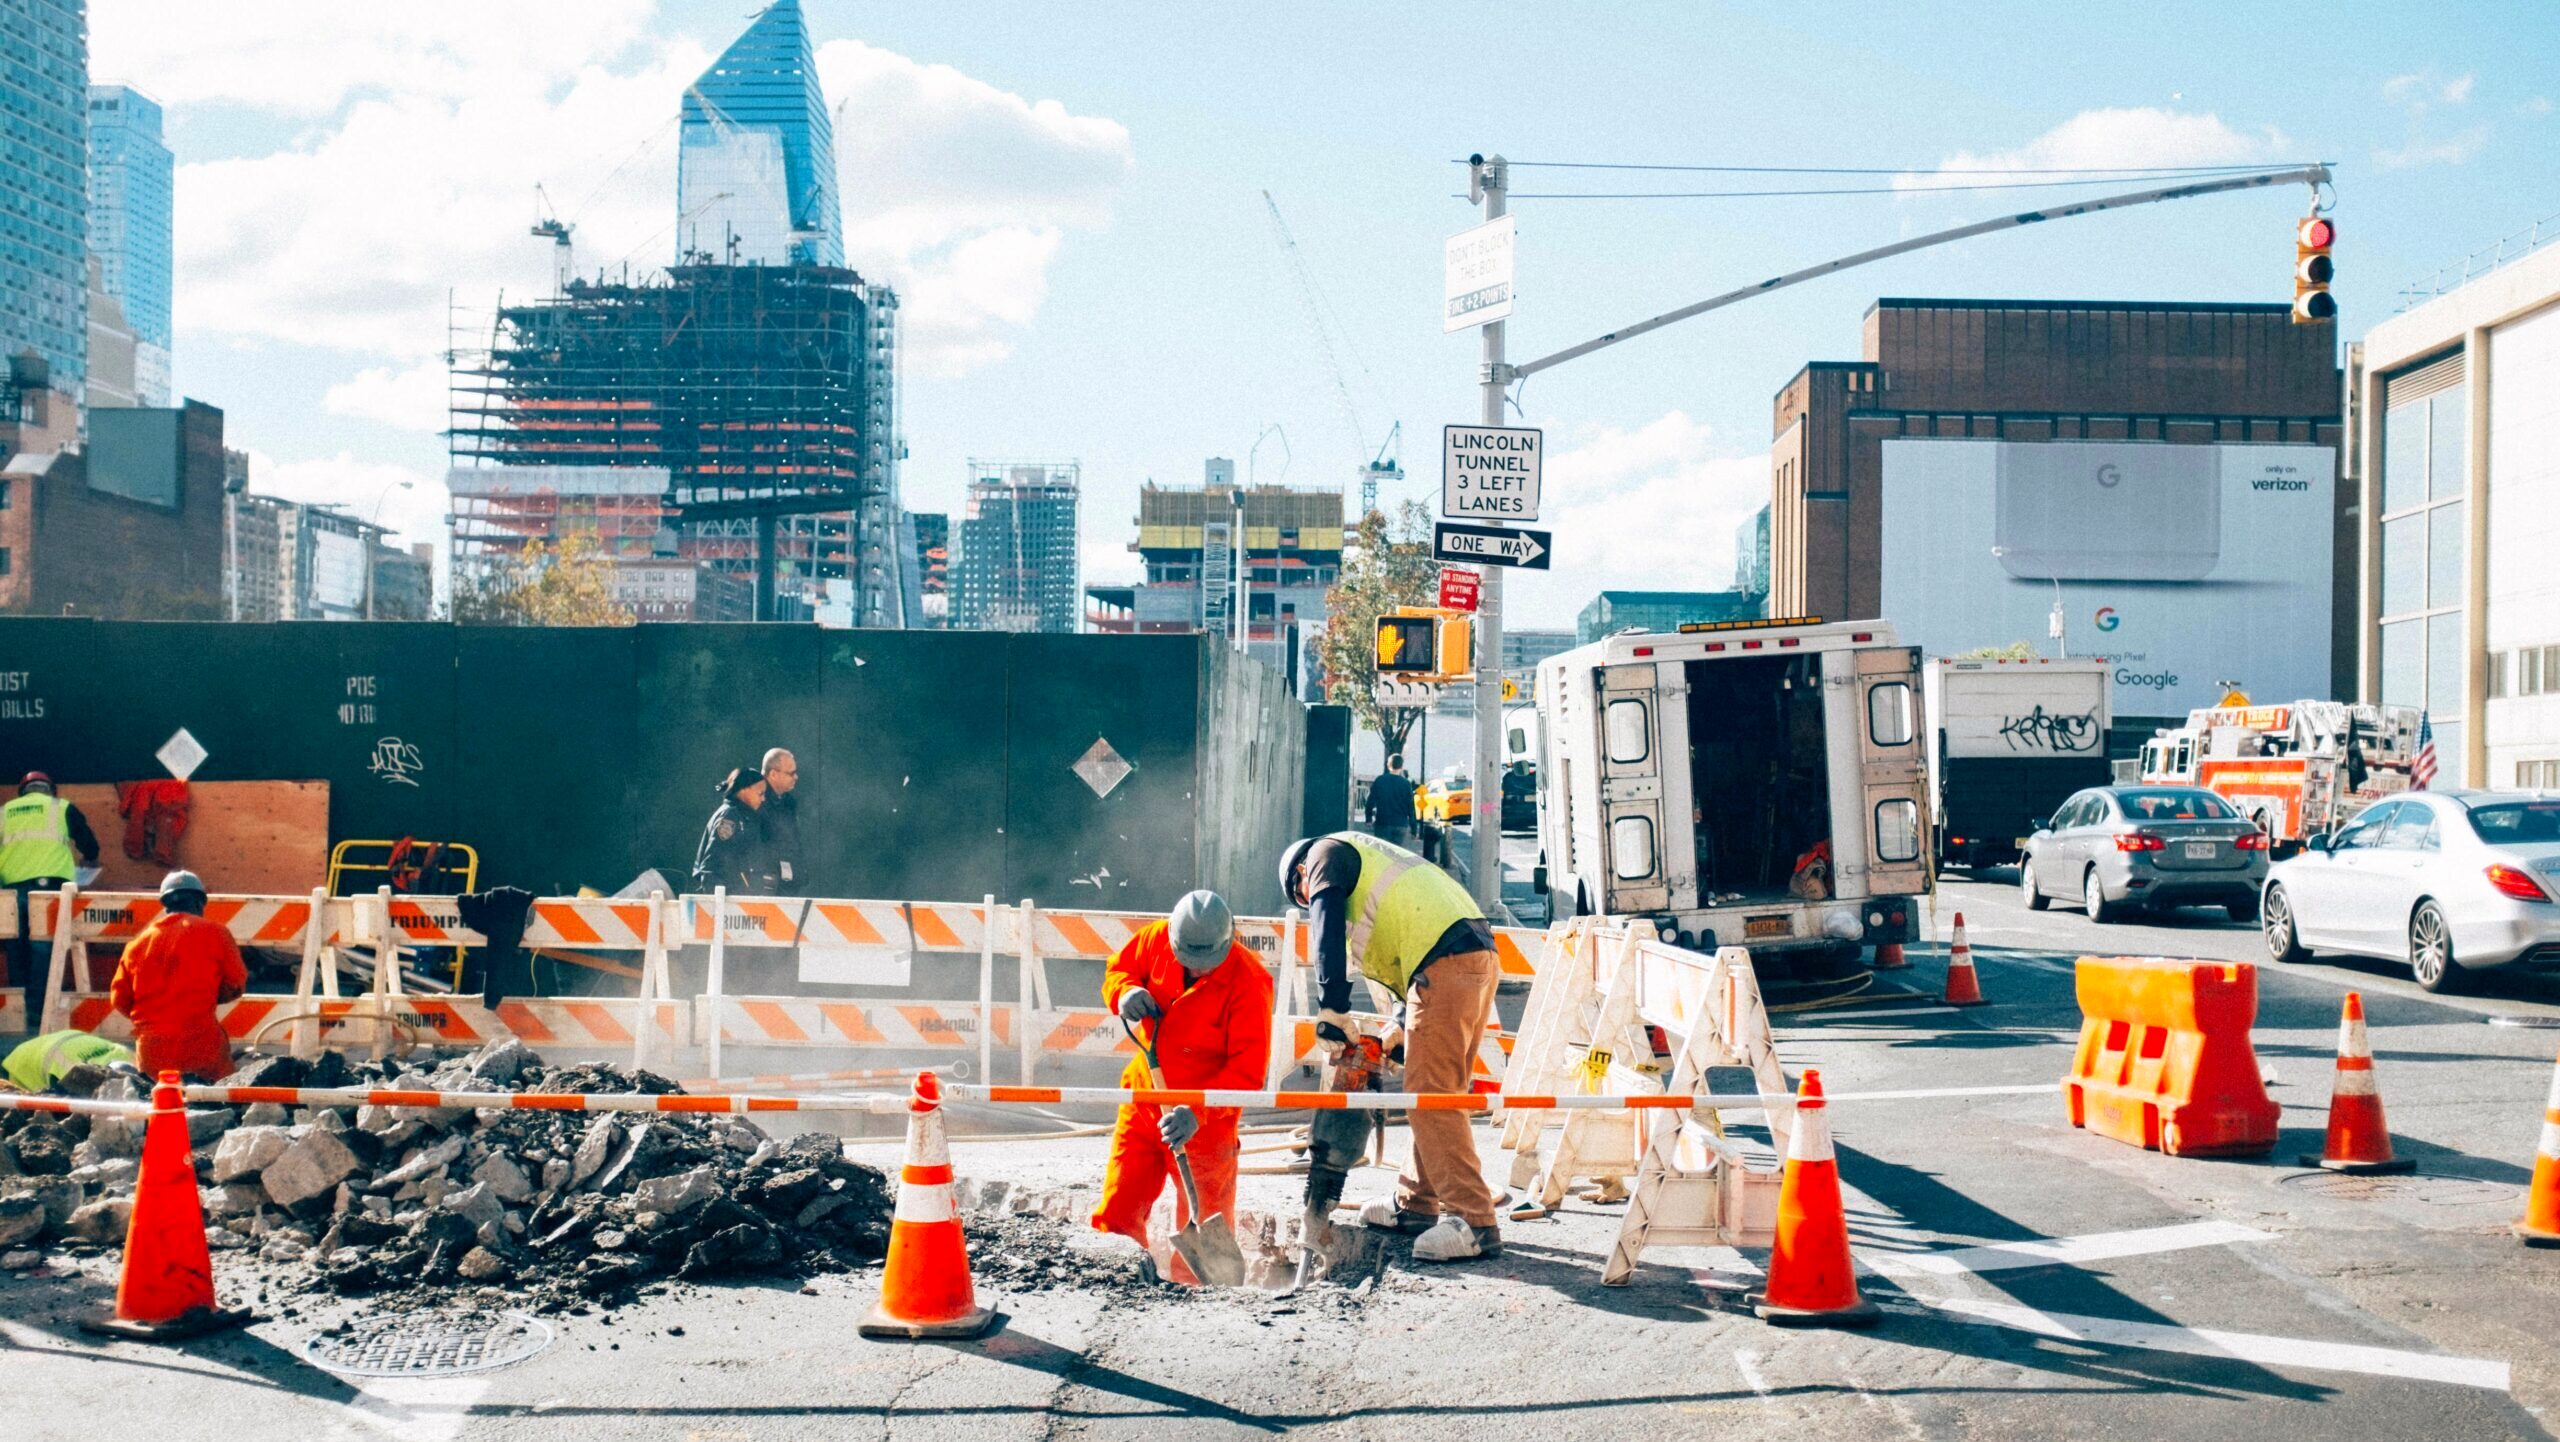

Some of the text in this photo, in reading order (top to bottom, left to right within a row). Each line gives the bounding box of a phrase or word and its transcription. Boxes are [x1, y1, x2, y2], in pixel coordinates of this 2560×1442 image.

[1480, 232, 1509, 254] BLOCK
[1460, 258, 1496, 279] THE BOX
[1480, 283, 1508, 307] POINTS
[1452, 433, 1534, 451] LINCOLN
[1455, 454, 1530, 472] TUNNEL
[2265, 465, 2283, 474] only
[1457, 474, 1526, 491] 3 LEFT
[2251, 477, 2308, 491] verizon
[1459, 495, 1523, 512] LANES
[1451, 535, 1534, 556] ONE WAY
[1452, 573, 1478, 585] STANDING
[1446, 584, 1473, 595] ANYTIME
[2094, 607, 2120, 632] G
[2124, 652, 2146, 662] Pixel
[2115, 668, 2179, 690] Google
[1, 698, 45, 718] BILLS
[83, 908, 134, 924] TRIUMPH
[722, 914, 768, 931] RIUMPH
[1061, 1024, 1115, 1039] TRIUMPH
